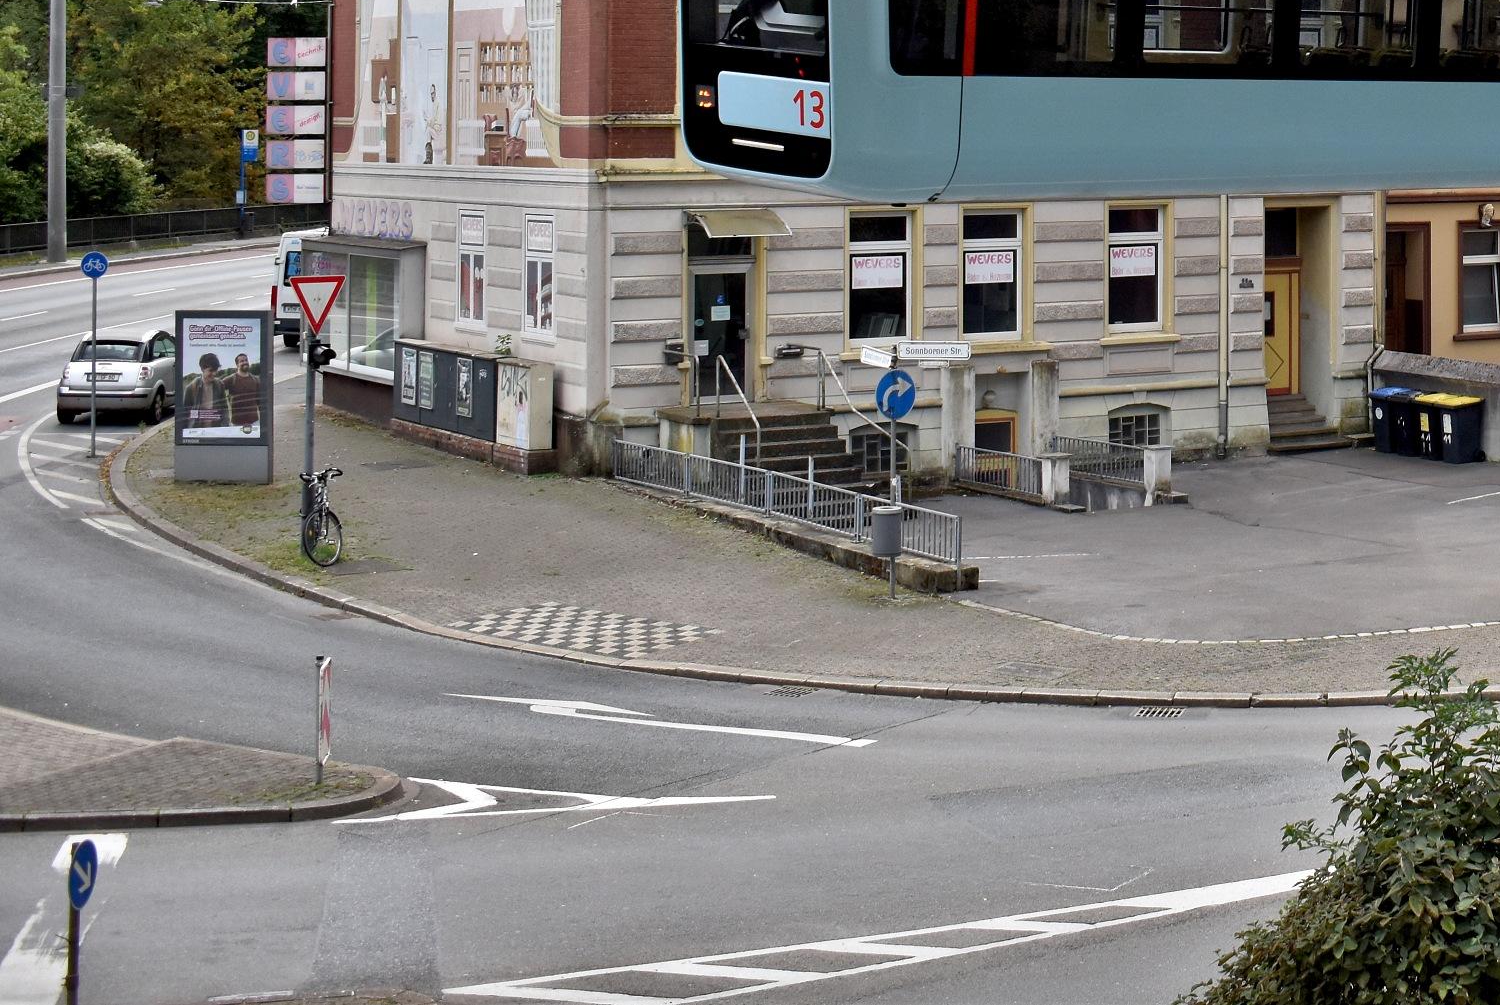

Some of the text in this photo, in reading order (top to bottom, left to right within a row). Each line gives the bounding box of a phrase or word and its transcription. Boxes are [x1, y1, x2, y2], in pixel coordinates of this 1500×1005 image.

[793, 89, 825, 129] 13
[1112, 248, 1154, 259] WEVERS
[854, 258, 900, 269] WEVERS
[967, 254, 1012, 265] WEVERS
[905, 347, 963, 355] Sonnborner Str.
